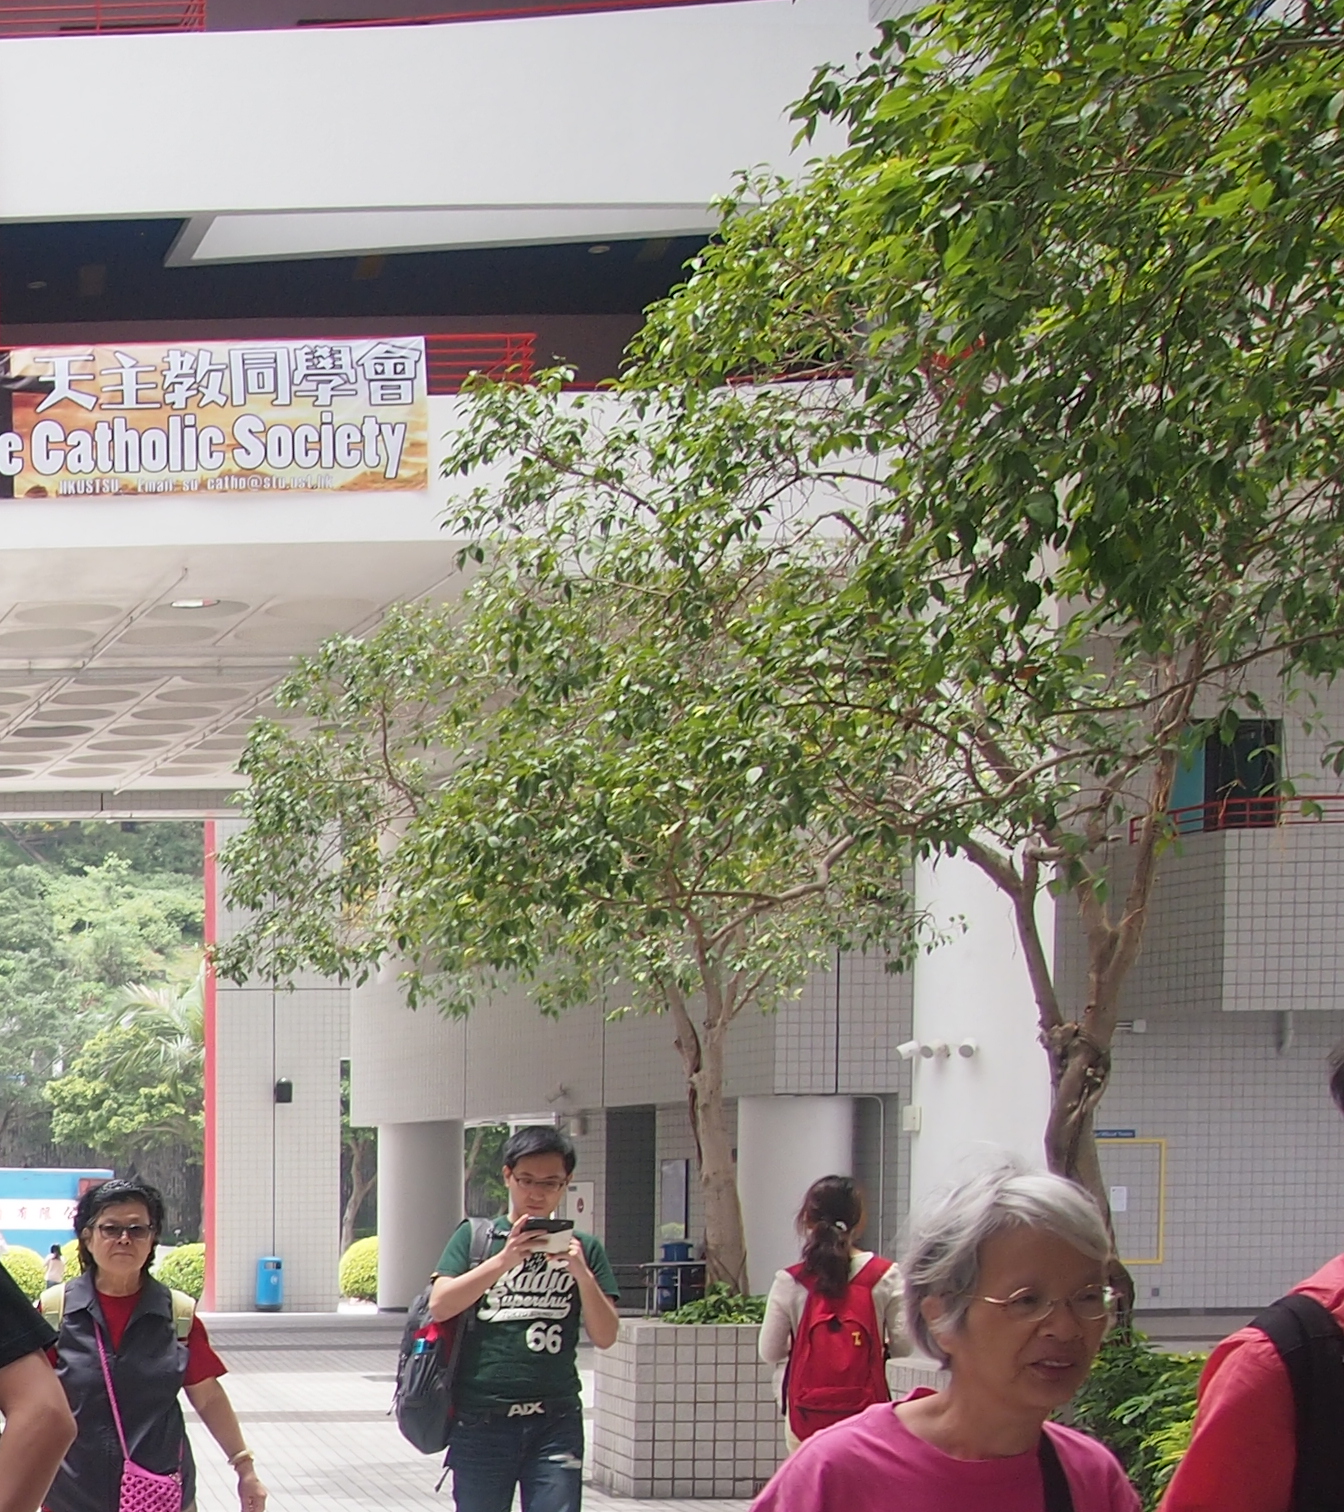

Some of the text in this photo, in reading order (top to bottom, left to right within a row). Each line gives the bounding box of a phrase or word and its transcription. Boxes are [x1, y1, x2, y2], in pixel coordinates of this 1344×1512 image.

[33, 341, 422, 414] 天主教同學會
[31, 413, 226, 475] Catholic
[233, 411, 408, 480] Society
[525, 1321, 563, 1354] 66
